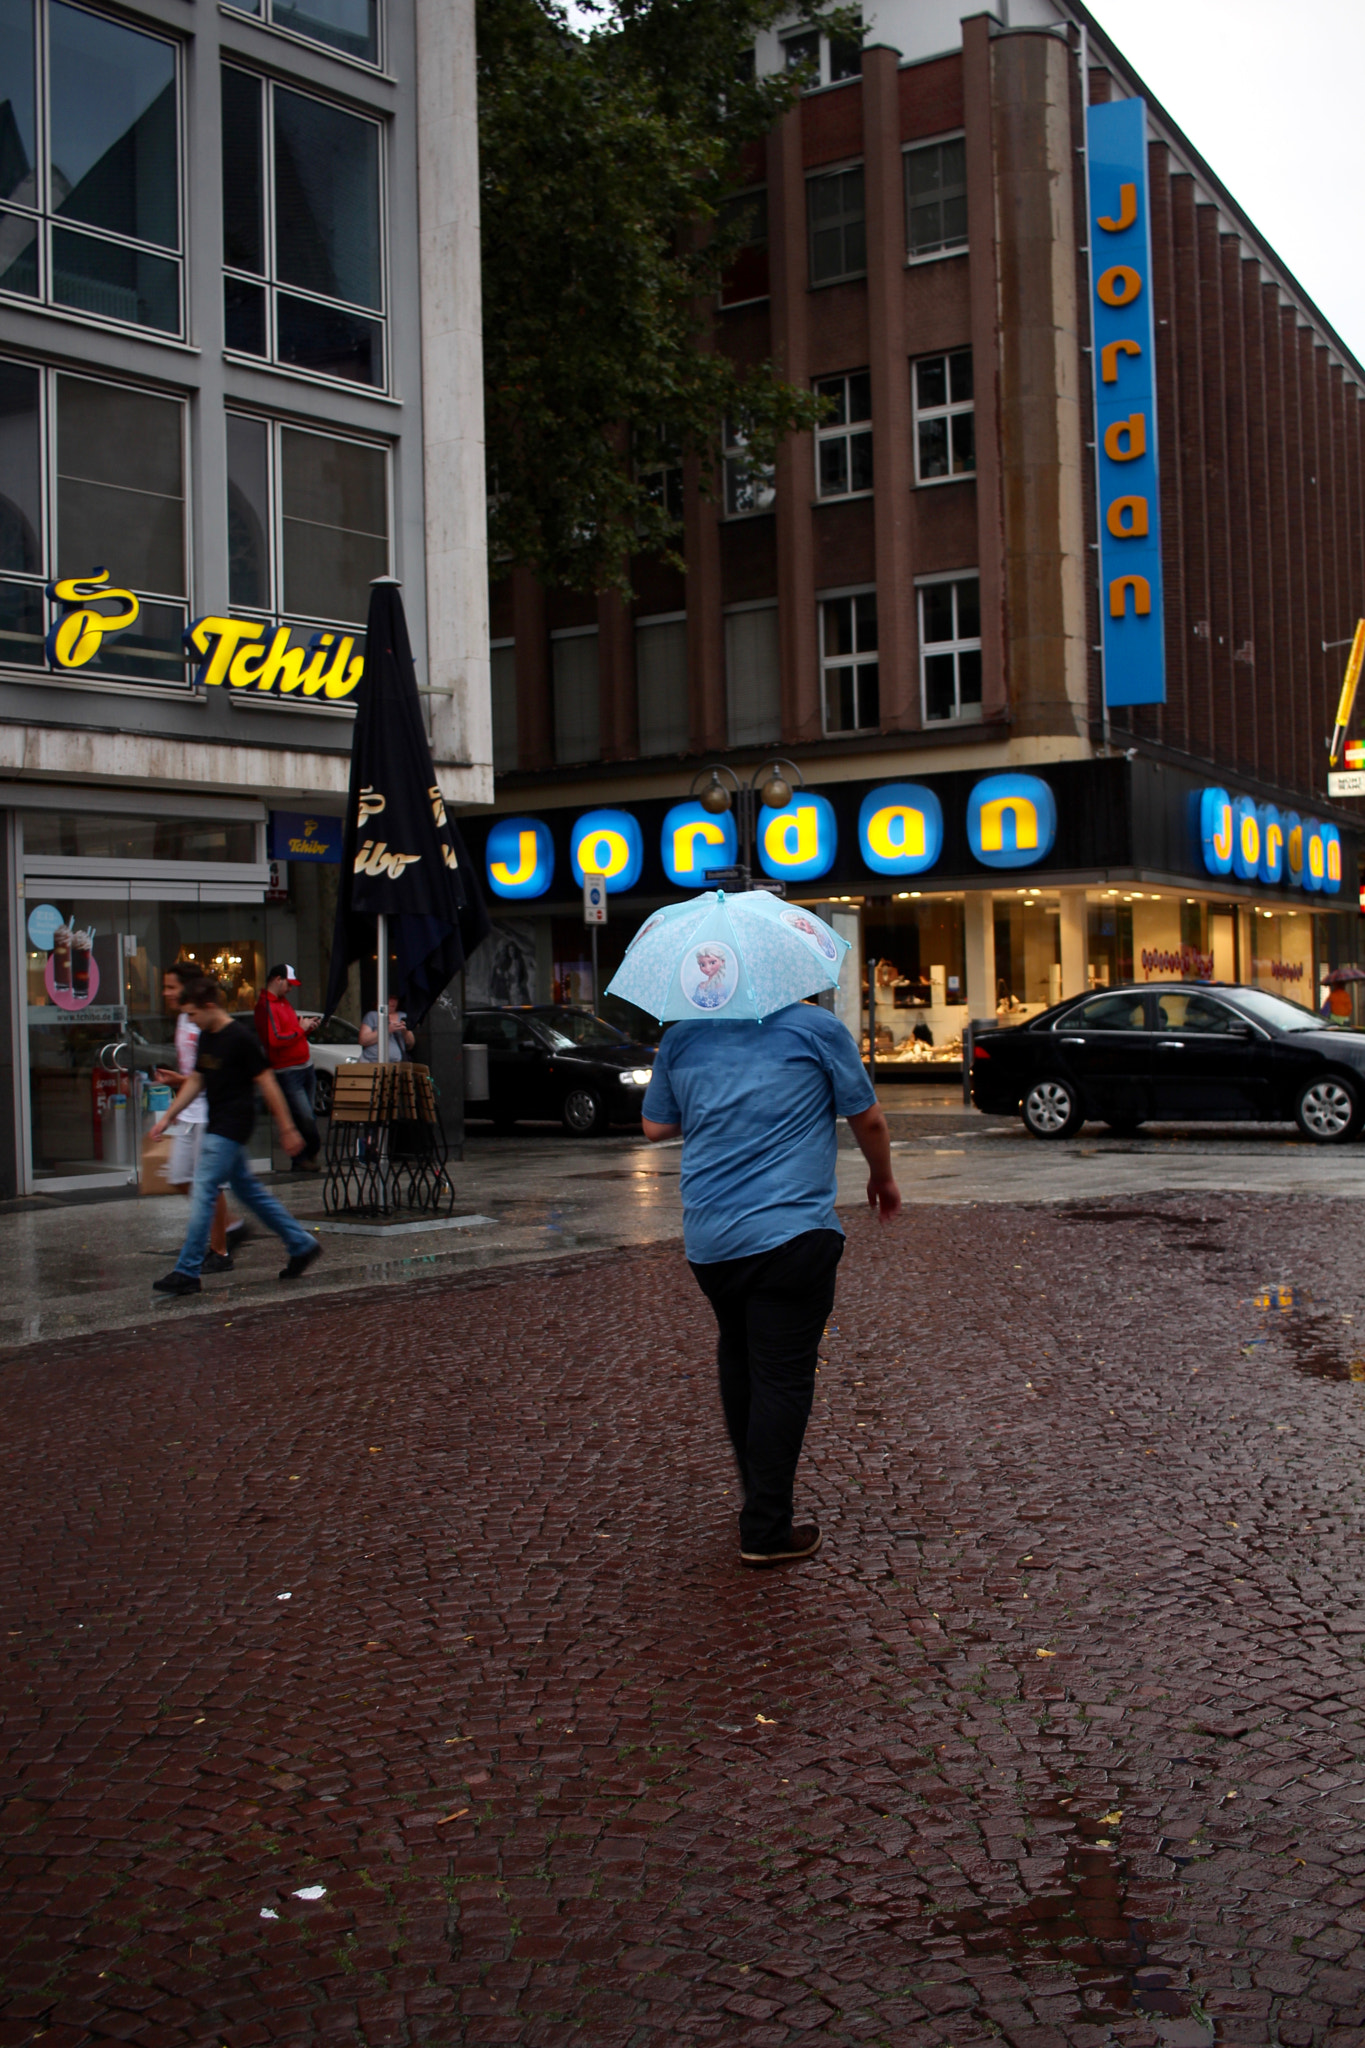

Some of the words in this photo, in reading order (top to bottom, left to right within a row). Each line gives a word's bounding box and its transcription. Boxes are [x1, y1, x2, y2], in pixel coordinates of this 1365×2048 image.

[1097, 182, 1151, 618] Jordan
[186, 615, 366, 700] Tchib
[288, 838, 330, 855] Tchibo
[354, 840, 421, 879] ibo
[490, 796, 1038, 886] Jordan
[1213, 804, 1341, 881] Jordan
